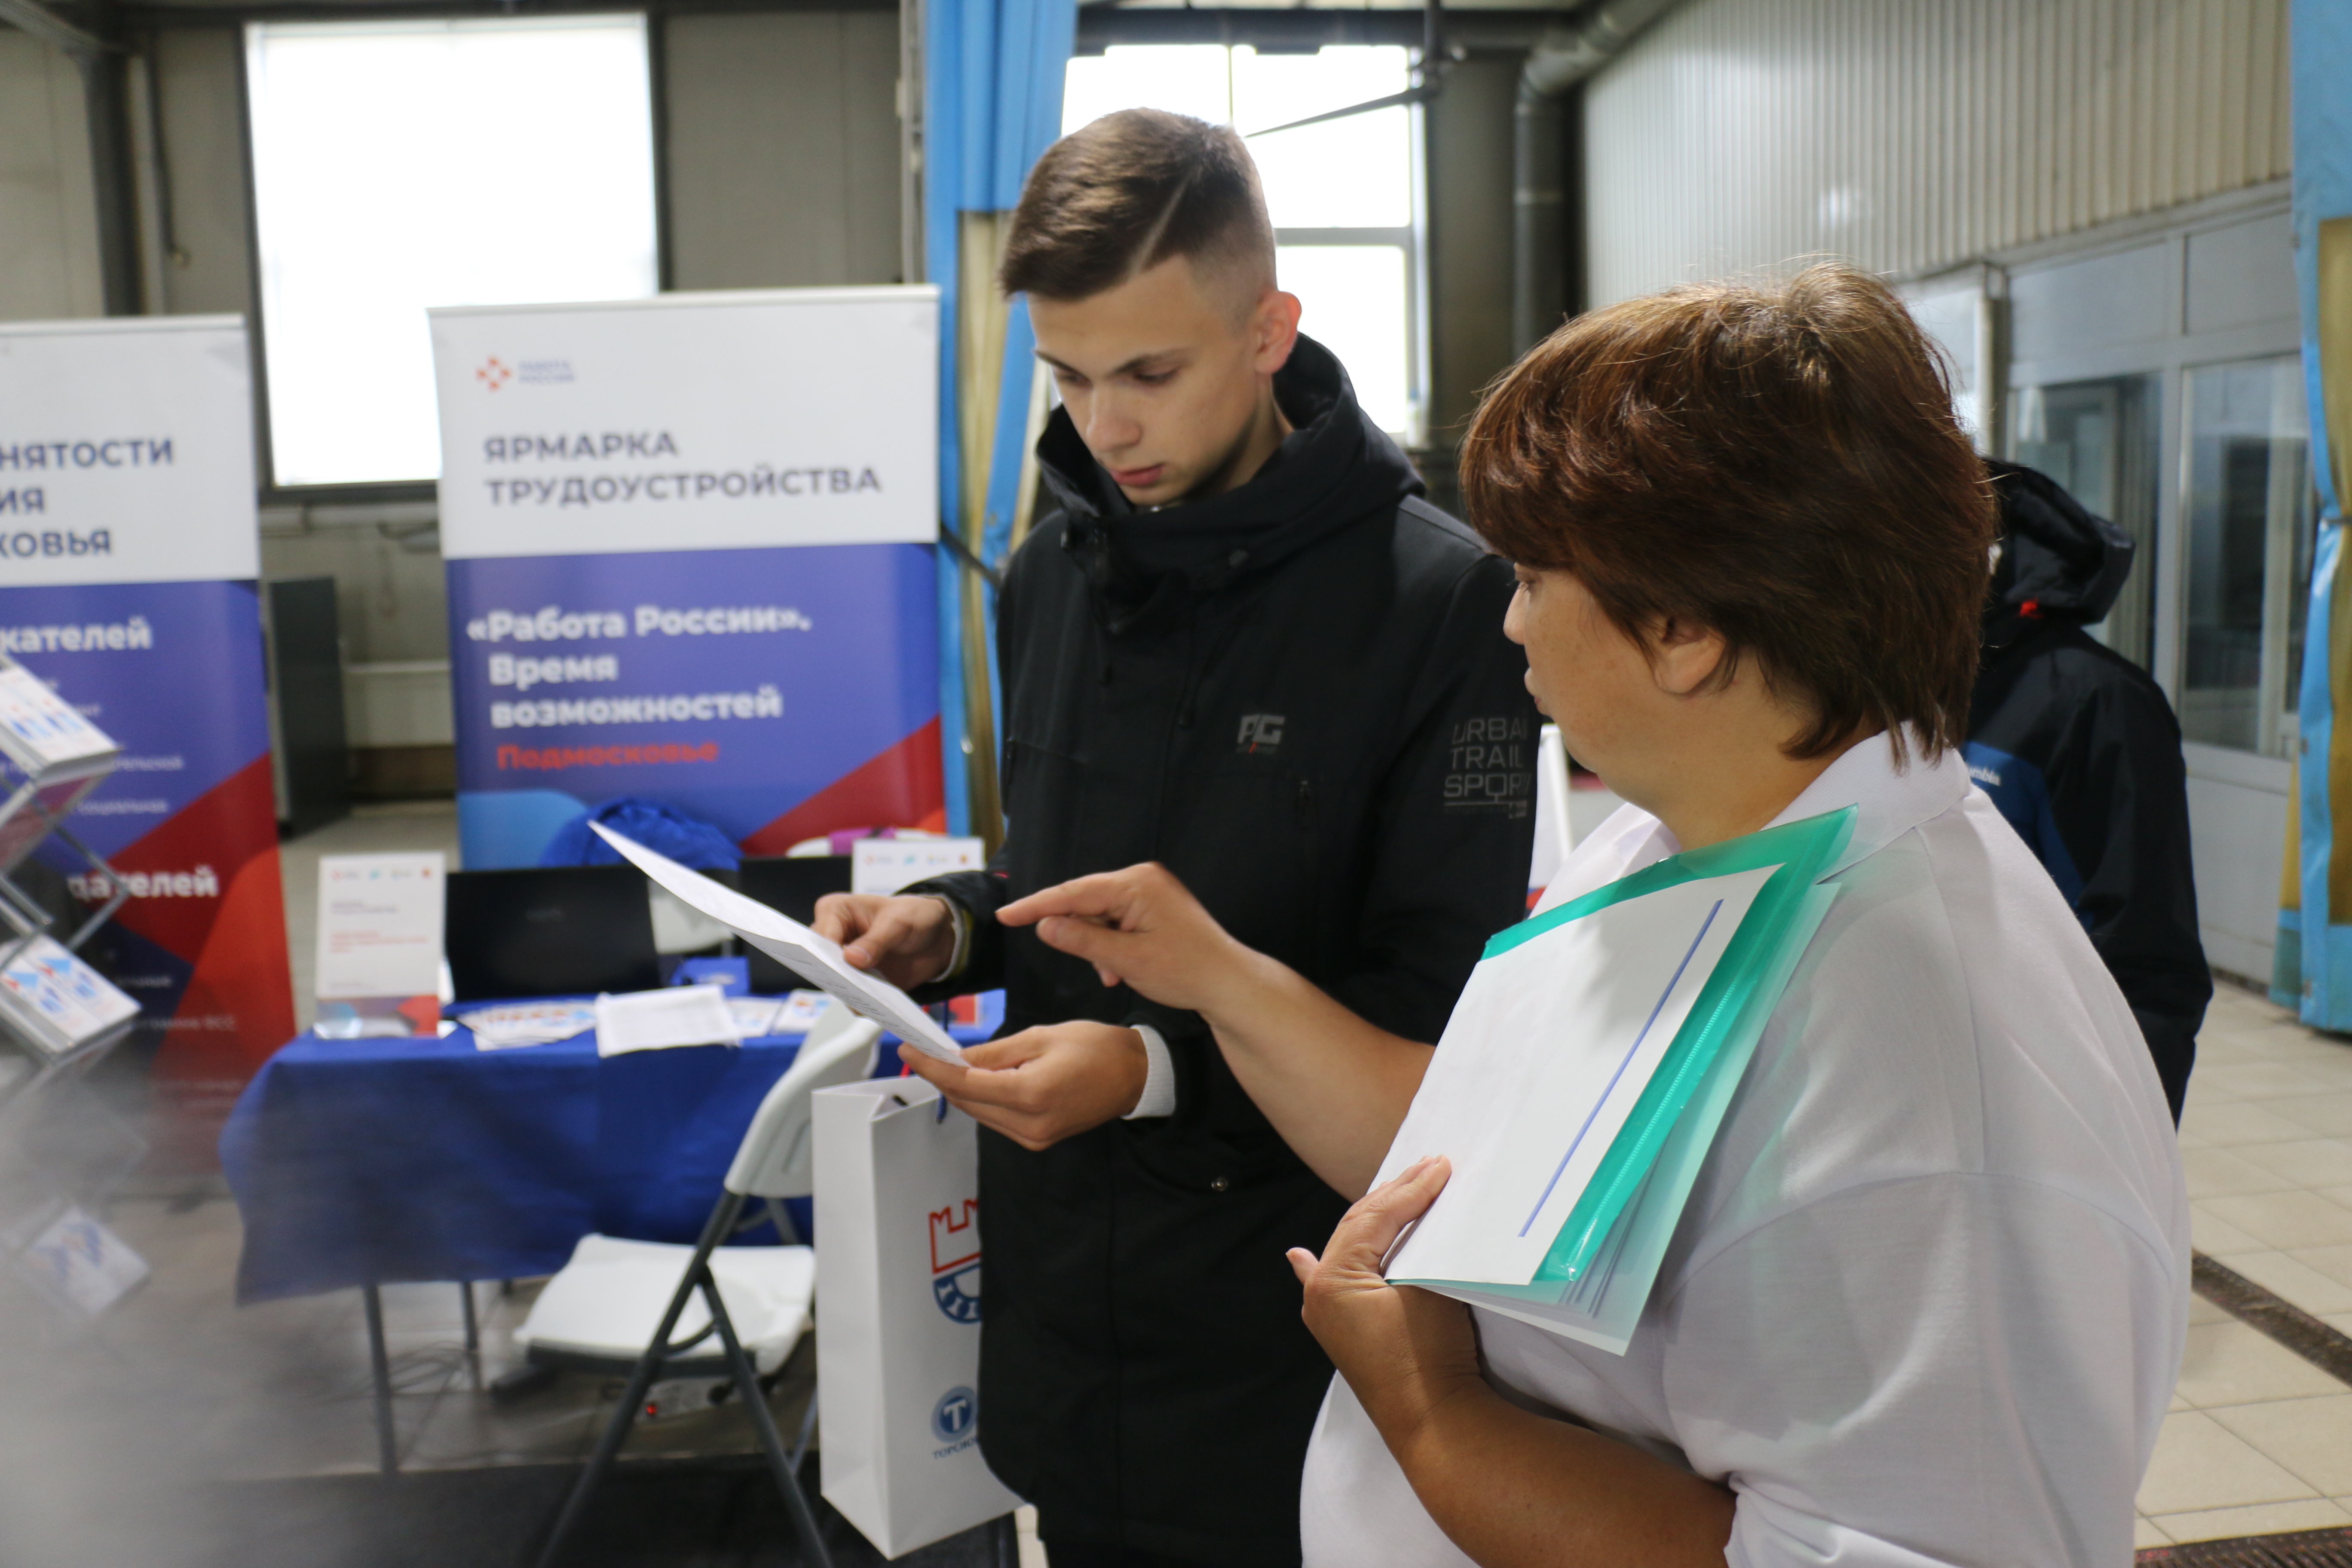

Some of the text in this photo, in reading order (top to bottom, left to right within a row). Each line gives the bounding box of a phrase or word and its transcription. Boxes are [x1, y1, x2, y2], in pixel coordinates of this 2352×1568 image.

[0, 438, 175, 470] НЯТОСТИ
[484, 430, 678, 463] ЯРМАРКА
[484, 464, 881, 508] ТРУДОУСТРОЙСТВА
[0, 616, 153, 653] кателей
[466, 605, 812, 643] «Работа России».
[488, 653, 619, 690] Время
[490, 685, 784, 729] возможностей
[496, 741, 720, 771] Подмосковье
[1450, 745, 1523, 770] TRAIL
[67, 864, 218, 902] даелей
